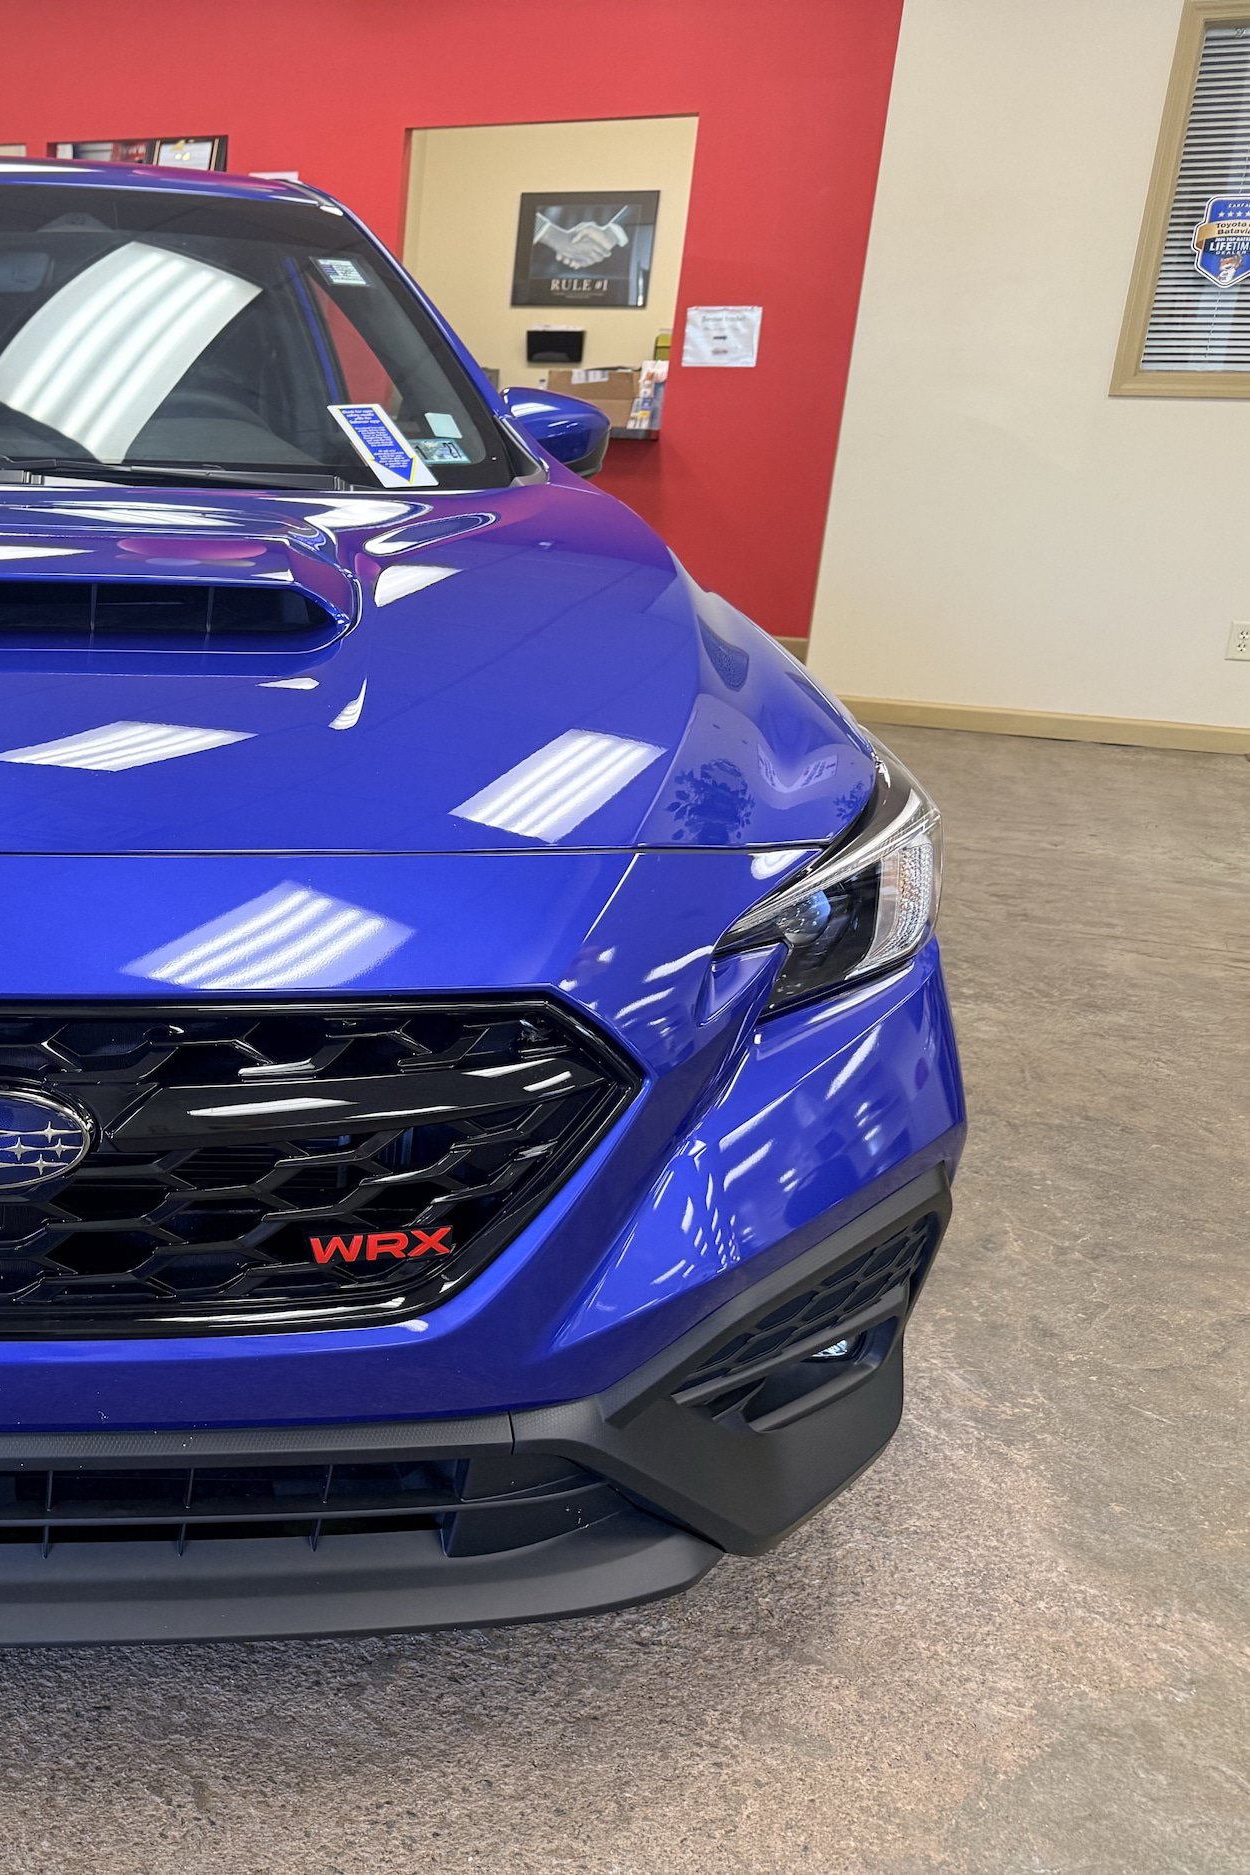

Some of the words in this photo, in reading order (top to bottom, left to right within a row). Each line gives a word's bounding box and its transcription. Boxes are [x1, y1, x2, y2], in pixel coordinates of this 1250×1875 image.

[1215, 221, 1247, 229] Toyota
[1209, 241, 1250, 251] LIFETIM
[550, 278, 592, 291] RULE
[595, 279, 609, 291] #1
[309, 1226, 452, 1265] WRX
